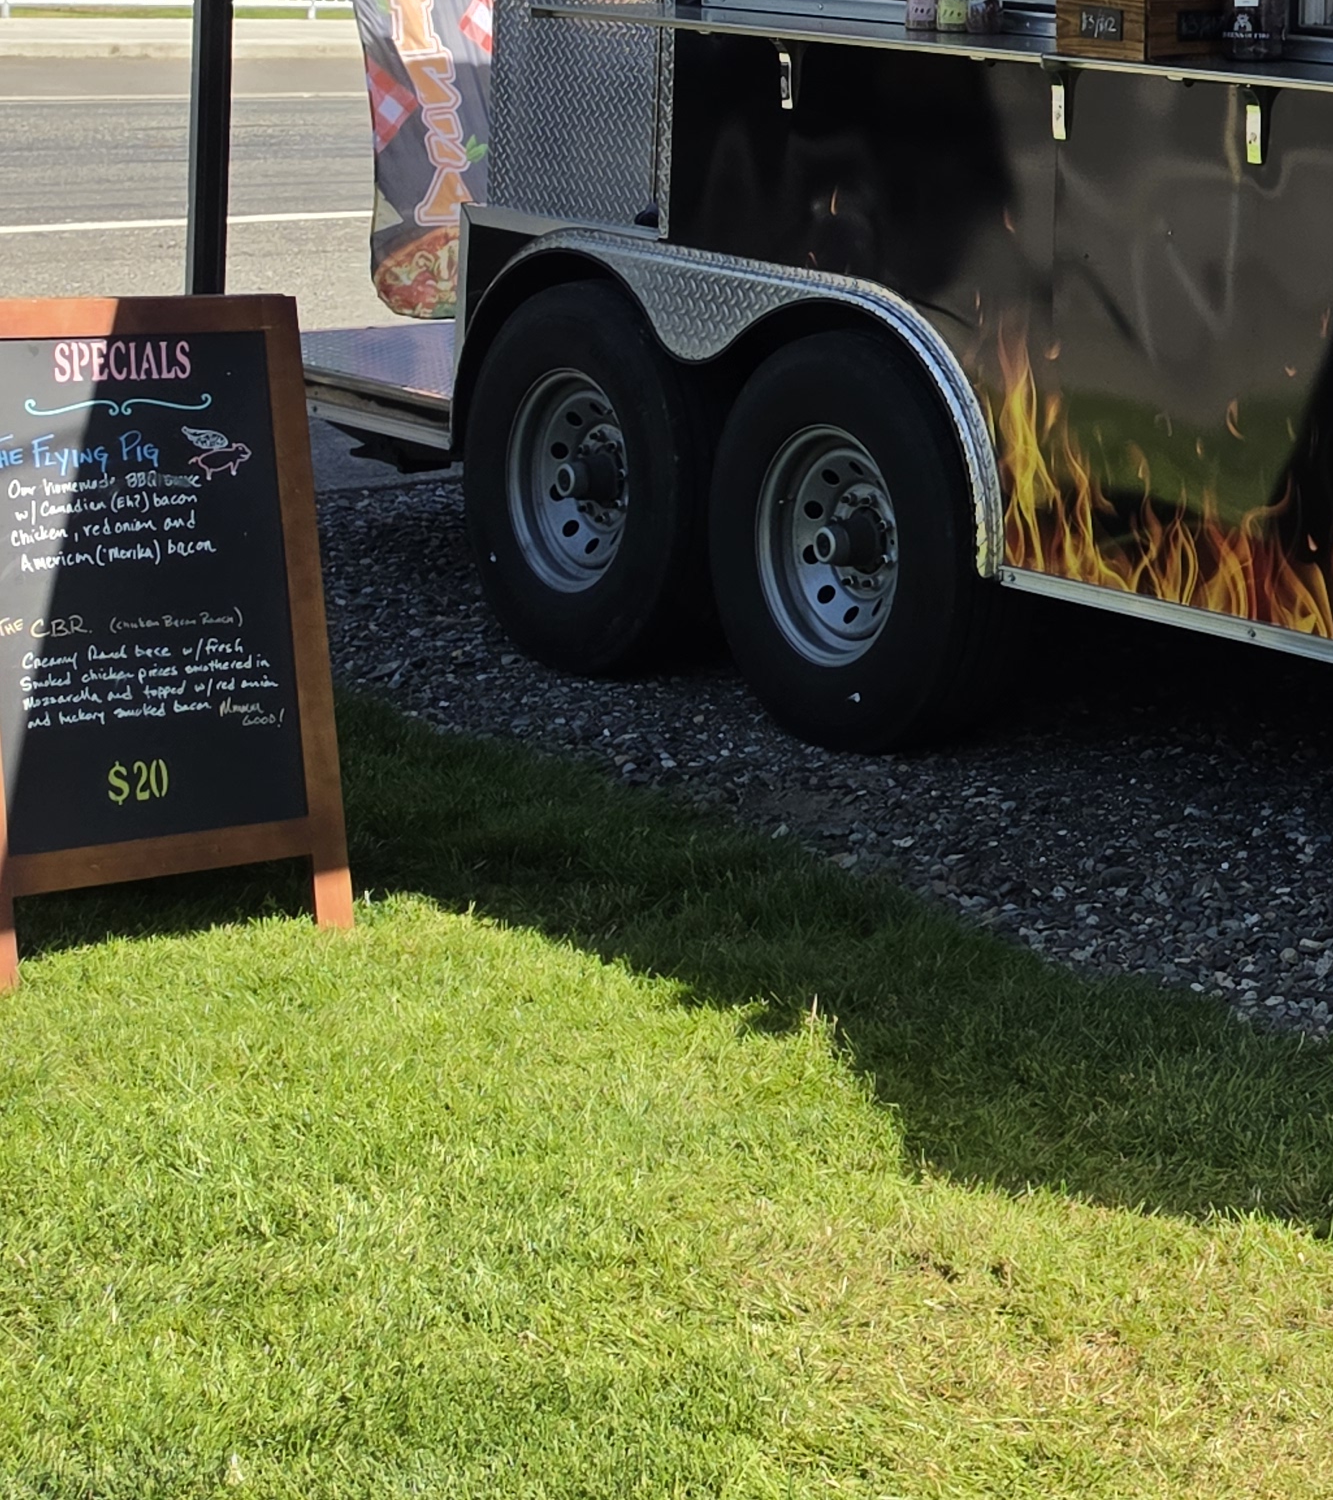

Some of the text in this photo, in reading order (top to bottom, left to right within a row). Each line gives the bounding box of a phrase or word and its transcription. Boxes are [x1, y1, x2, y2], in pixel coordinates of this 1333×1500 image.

[54, 340, 192, 382] SPECIALS
[31, 433, 109, 476] FLYING
[118, 429, 159, 468] PIG
[152, 492, 198, 508] bacon
[163, 508, 196, 532] and
[167, 538, 217, 557] bacon
[108, 758, 170, 806] $20
